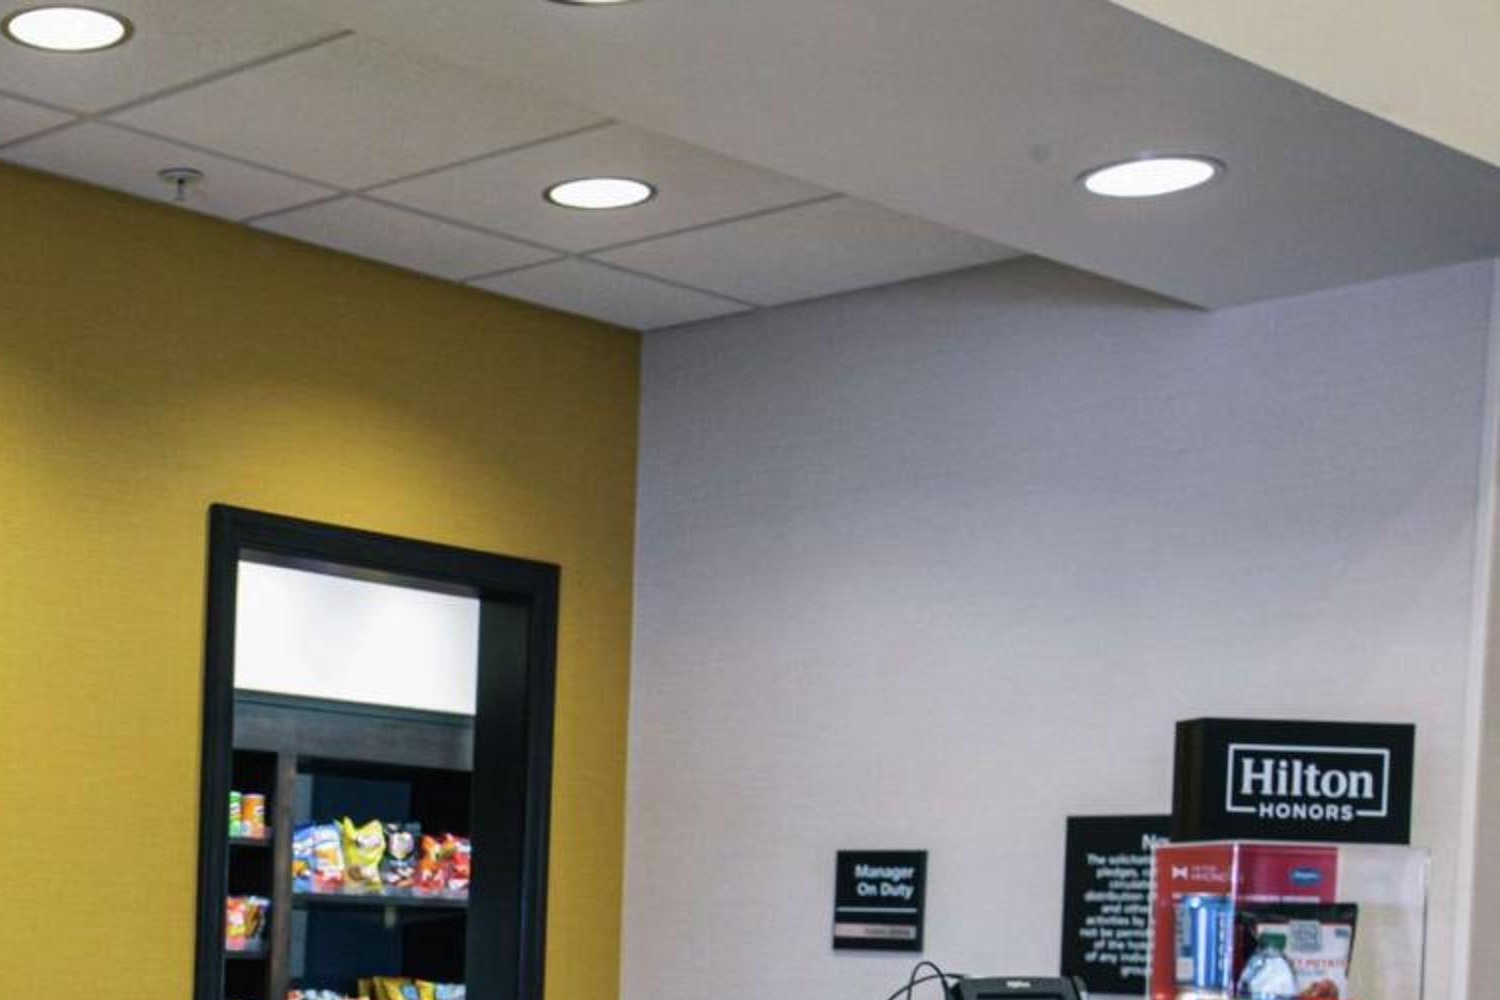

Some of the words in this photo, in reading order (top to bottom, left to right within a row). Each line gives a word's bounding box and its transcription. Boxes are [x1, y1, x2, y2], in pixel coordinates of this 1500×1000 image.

[1240, 758, 1375, 799] Hilton
[1259, 802, 1354, 821] HONORS
[854, 864, 915, 881] Manager
[857, 882, 878, 896] On
[880, 882, 915, 899] Duty
